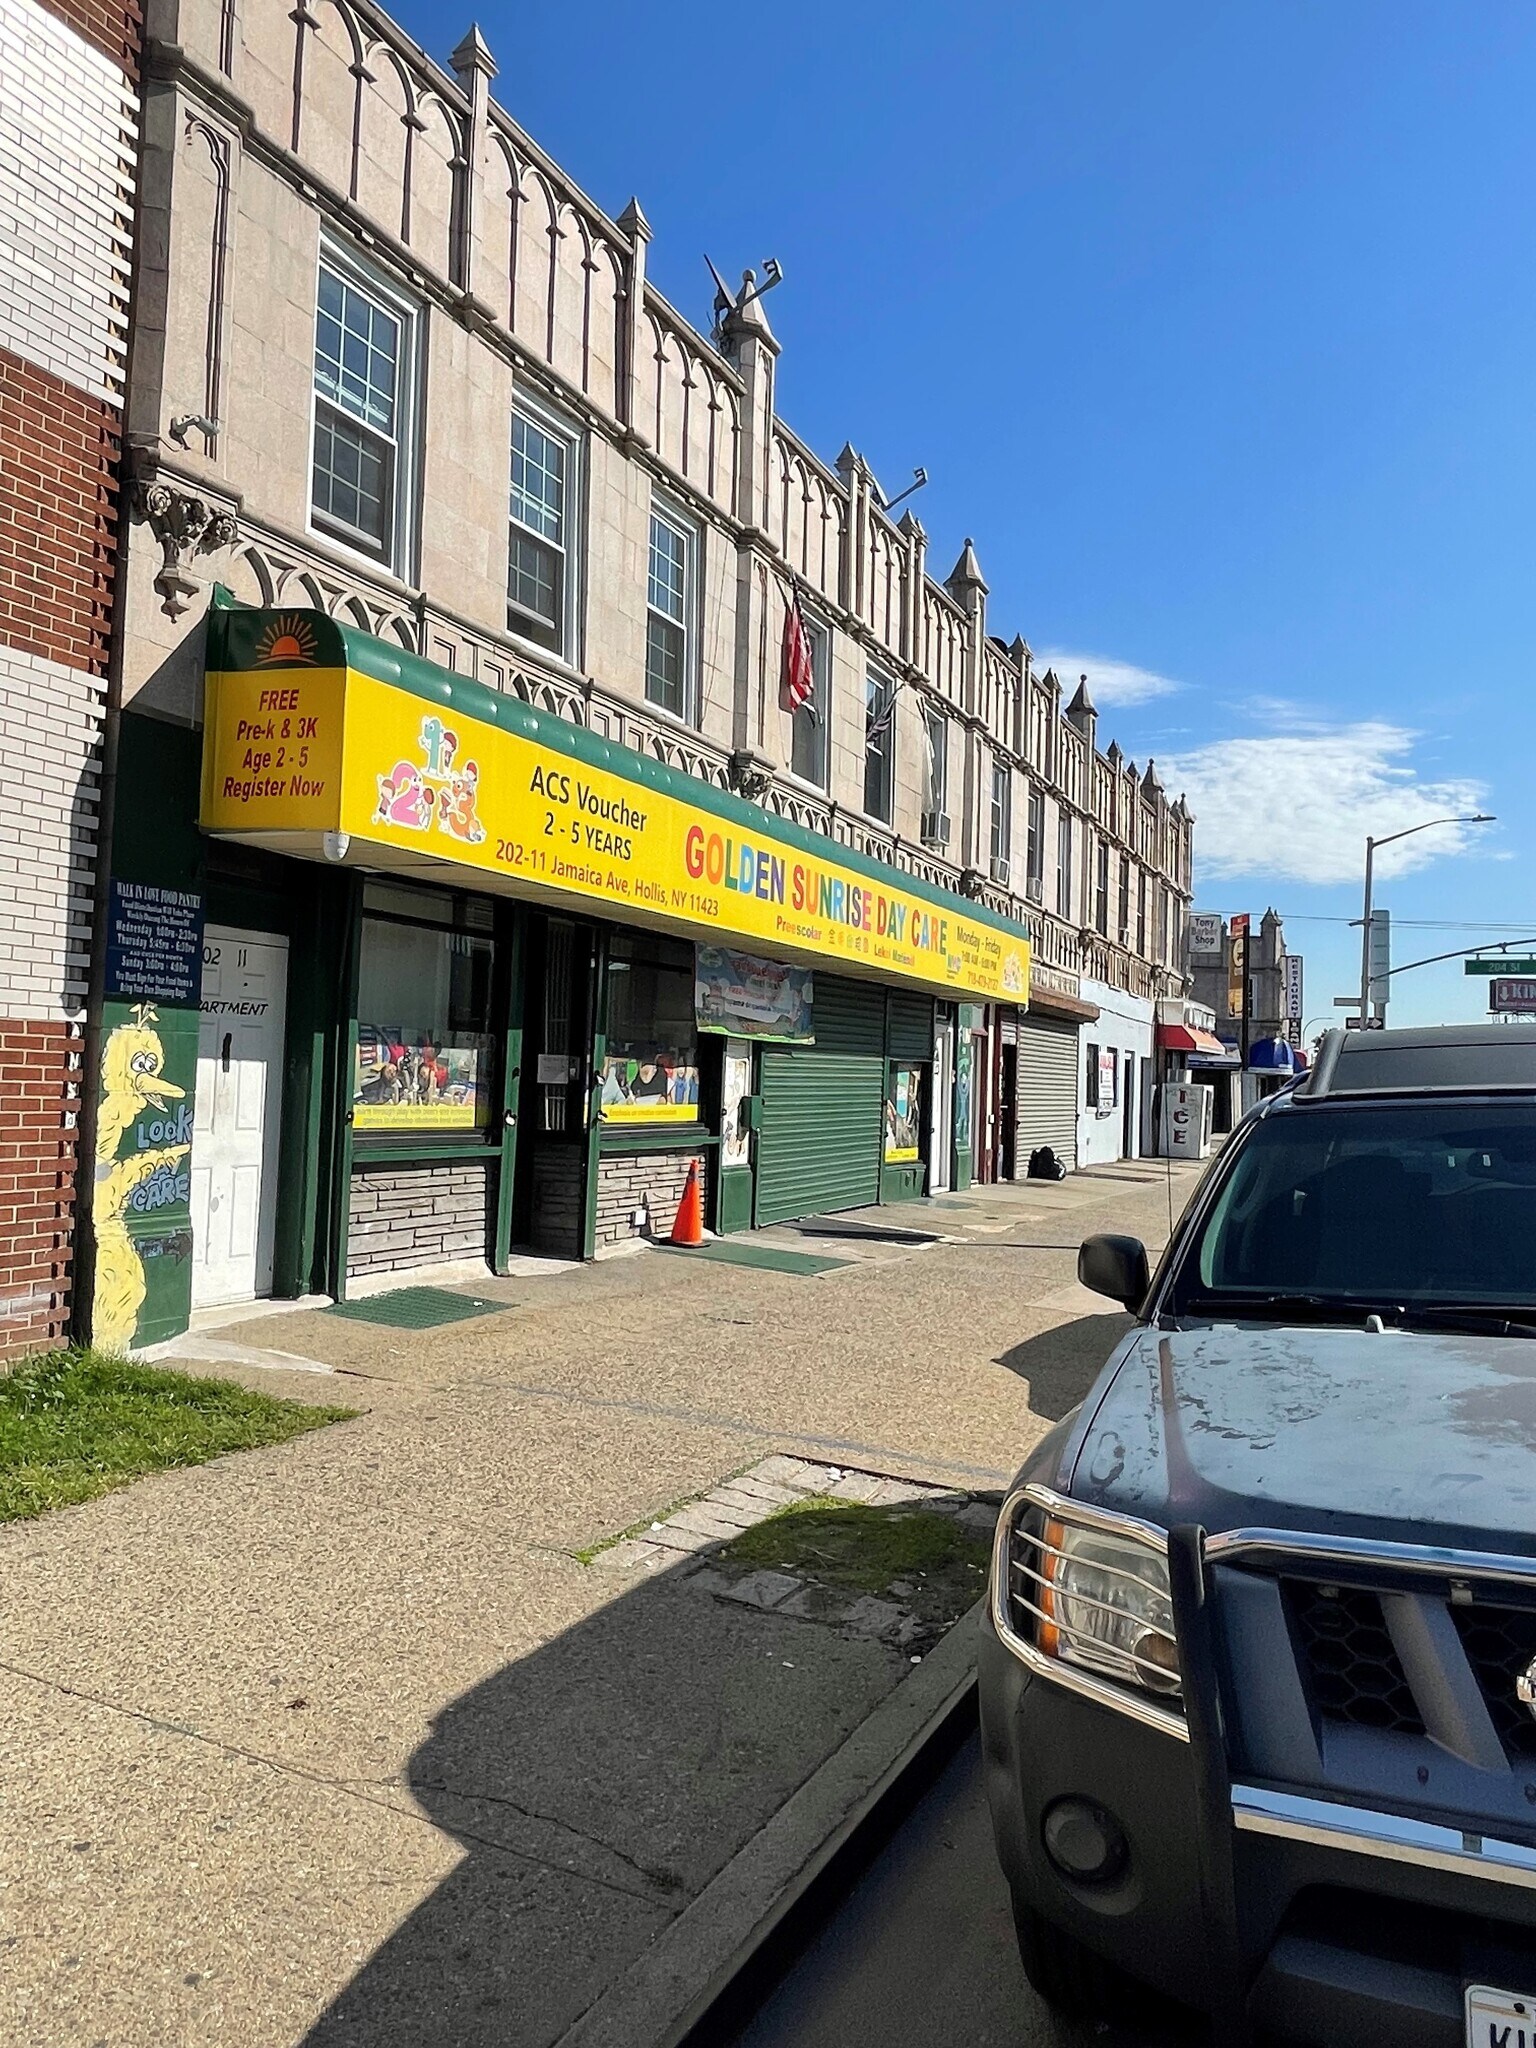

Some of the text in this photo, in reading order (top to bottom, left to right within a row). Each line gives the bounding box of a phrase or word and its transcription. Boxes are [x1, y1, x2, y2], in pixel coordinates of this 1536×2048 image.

[258, 689, 300, 712] FREE
[236, 717, 320, 742] Pre-k & 3K
[242, 748, 271, 774] Age
[276, 747, 286, 768] 2
[299, 746, 309, 768] 5
[223, 774, 325, 803] Register Now
[529, 765, 648, 832] ACS Voucher
[544, 812, 554, 836] 2
[571, 821, 580, 844] 5
[585, 824, 633, 861] YEARS
[496, 839, 720, 917] 202-11 Jamaica Ave, Hollis, NY 11423
[685, 825, 786, 906] GOLDEN
[792, 864, 872, 932] SUNRISE
[876, 895, 908, 942] DAY
[911, 909, 948, 956] CARE
[117, 881, 201, 909] WALK IN LOVE FOOD PANTRY
[116, 919, 152, 938] Wednesday
[776, 915, 823, 941] Preescolar
[1191, 927, 1219, 936] Barber
[1194, 918, 1215, 928] Tony
[117, 932, 148, 950] Thursday
[956, 926, 980, 953] Monday
[985, 937, 1001, 960] Friday
[1194, 936, 1216, 945] Shop
[121, 955, 144, 971] Sunday
[1488, 962, 1507, 973] 204
[1290, 958, 1299, 1018] RESTAURANT
[1173, 1089, 1190, 1145] ICE
[139, 1156, 182, 1186] DAY
[132, 1173, 190, 1212] CARE
